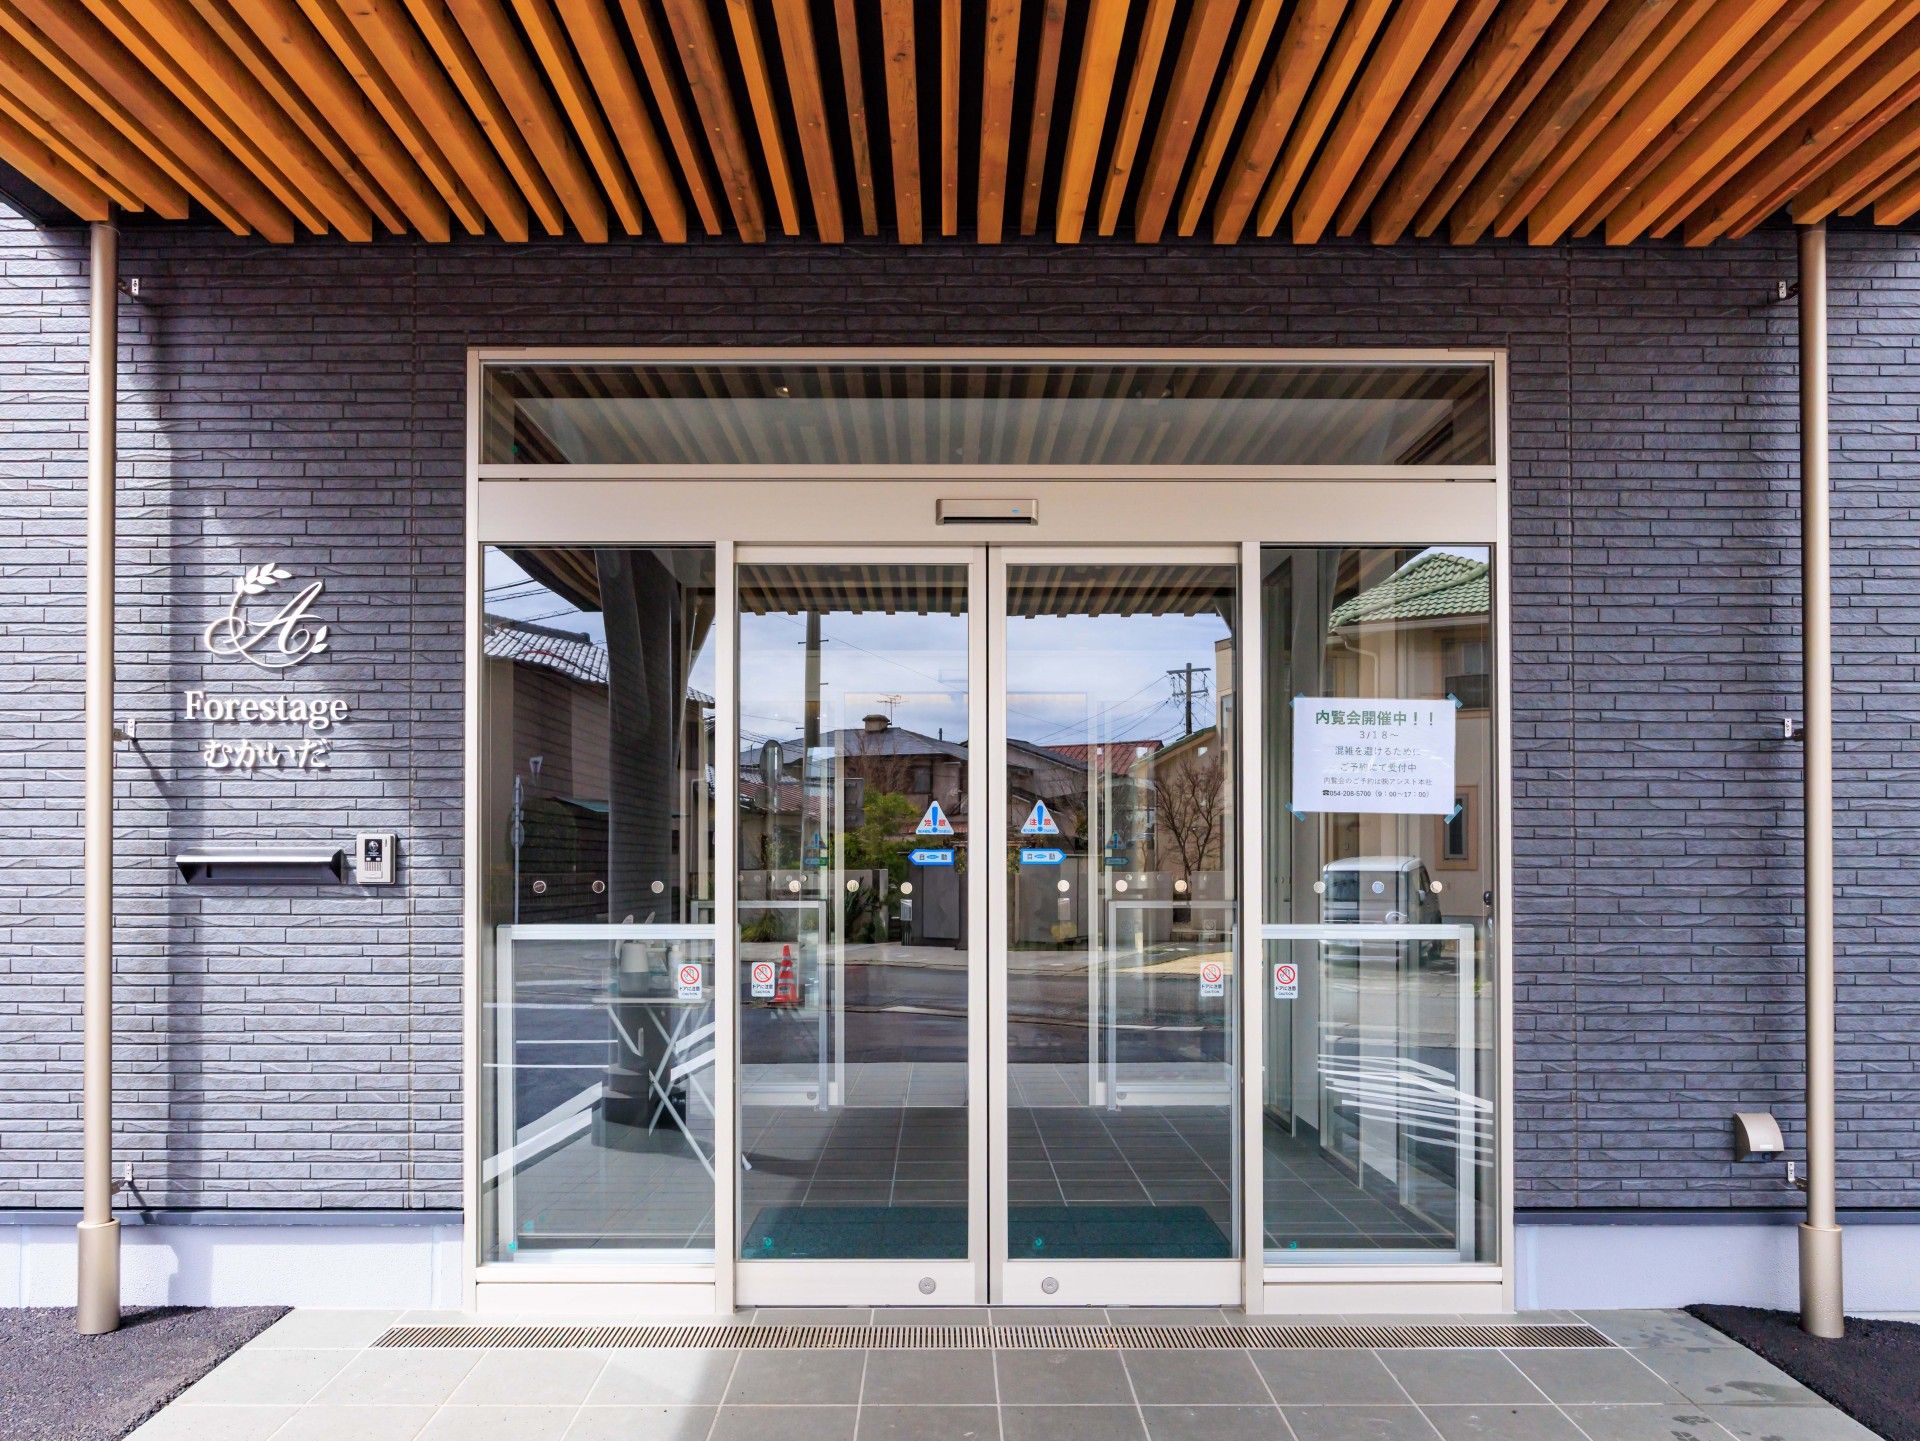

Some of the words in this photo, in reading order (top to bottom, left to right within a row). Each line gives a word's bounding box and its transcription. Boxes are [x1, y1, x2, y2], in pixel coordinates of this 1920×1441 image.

[184, 690, 348, 730] Forestage
[1315, 709, 1433, 727] 内覧会開催中！！
[203, 738, 333, 769] むかいだ
